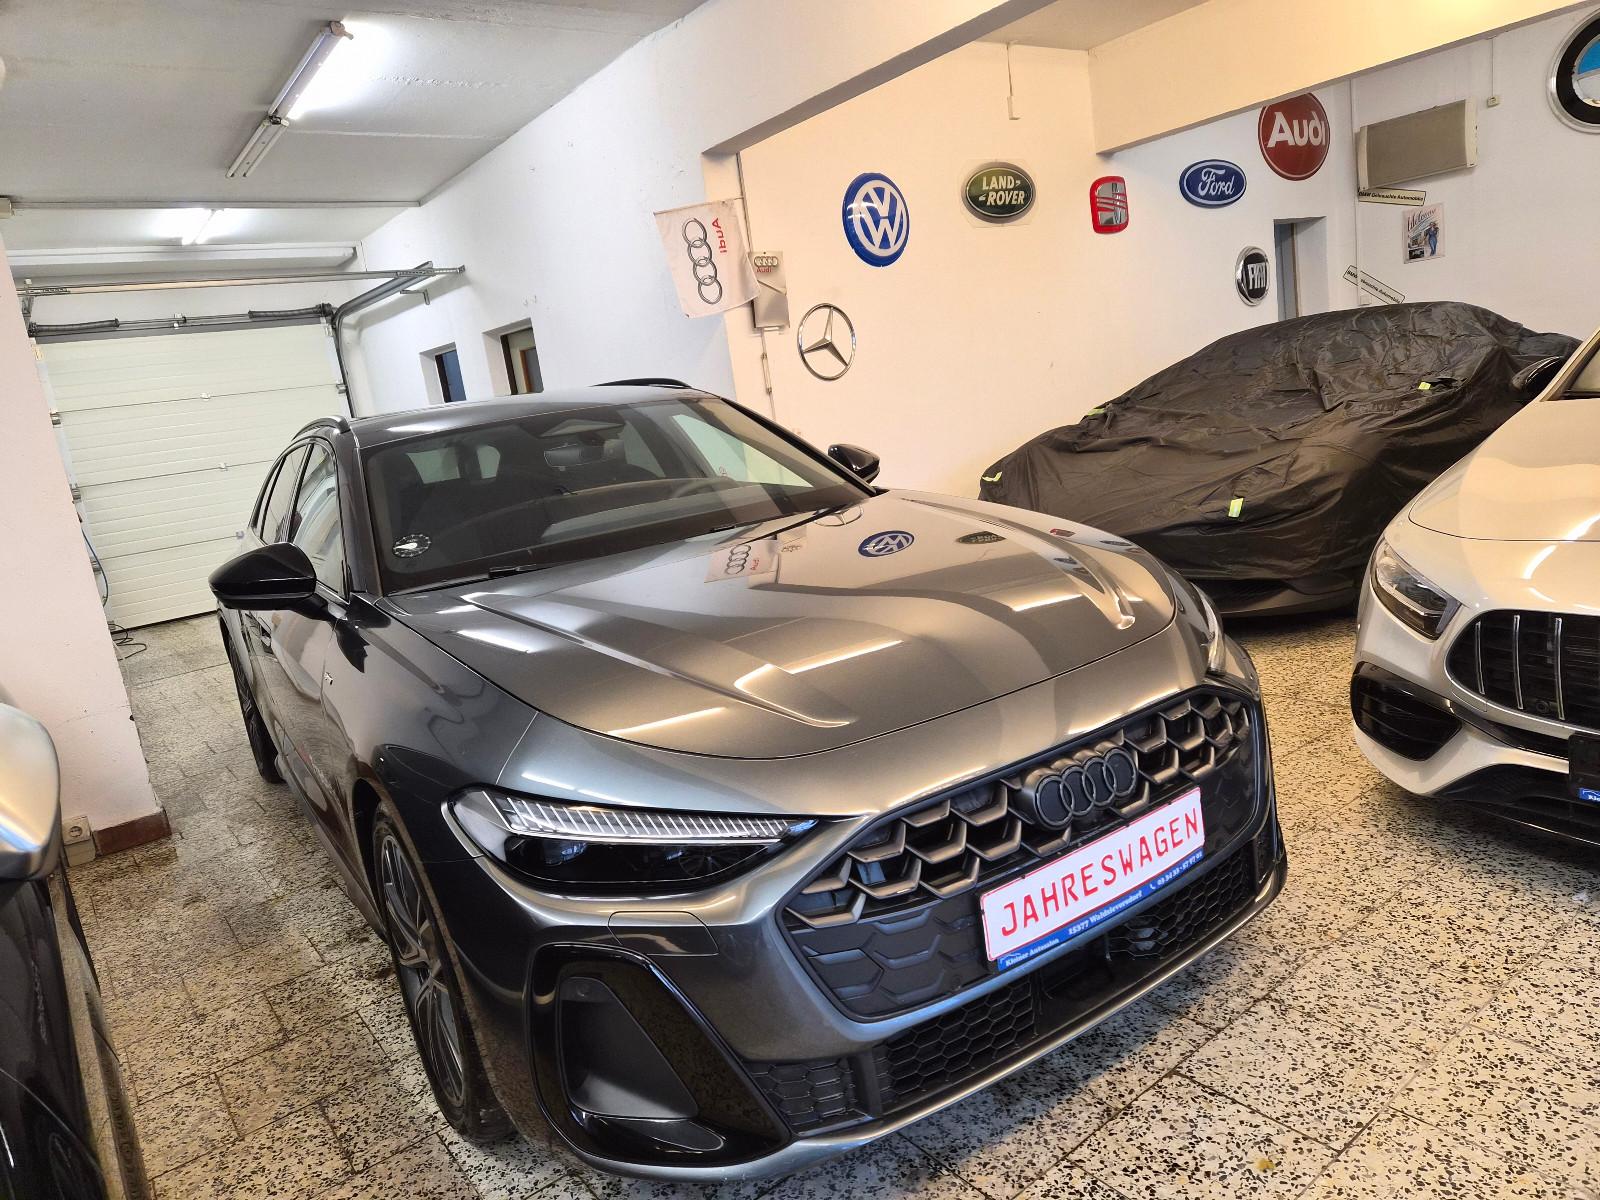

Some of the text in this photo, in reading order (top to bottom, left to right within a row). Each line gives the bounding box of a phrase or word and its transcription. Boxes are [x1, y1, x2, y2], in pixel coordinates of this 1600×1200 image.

[1267, 111, 1326, 148] Audi
[1198, 168, 1235, 196] Ford
[987, 191, 1025, 206] ROVER
[711, 217, 727, 253] Audi
[1247, 262, 1266, 290] FIAT
[1001, 807, 1199, 937] JAHRESWAGEN
